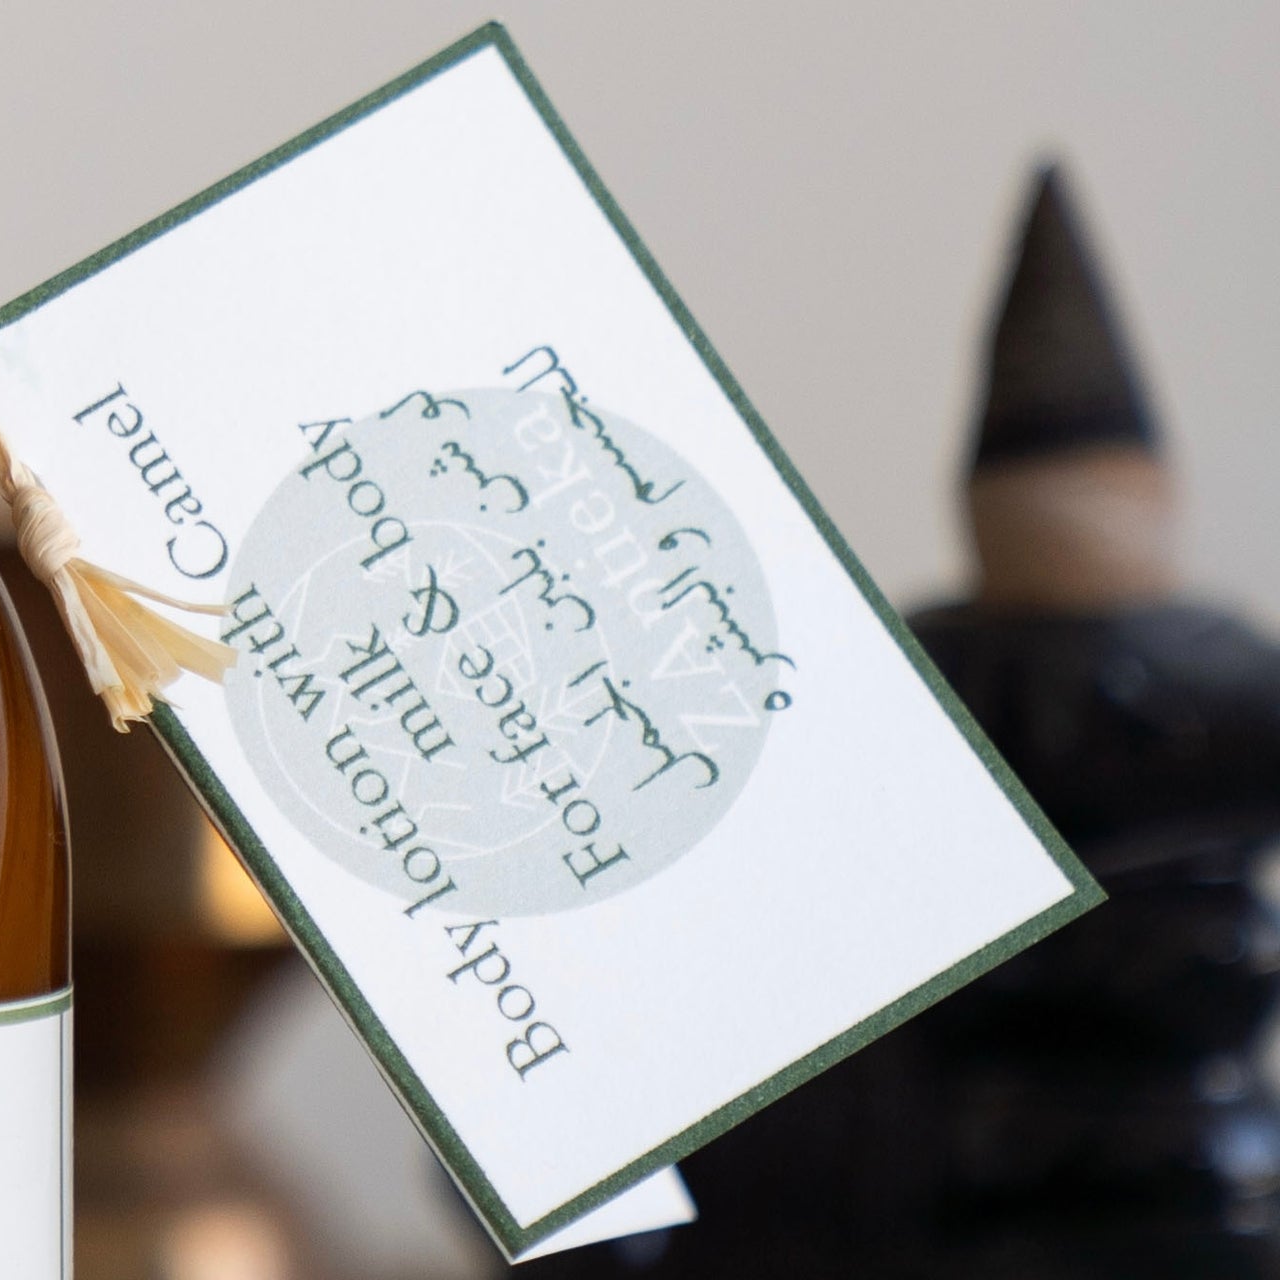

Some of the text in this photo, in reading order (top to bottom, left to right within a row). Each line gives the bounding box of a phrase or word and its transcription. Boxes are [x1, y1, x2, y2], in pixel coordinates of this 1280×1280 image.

[378, 389, 720, 791] لوشن بلبن الجمل
[501, 344, 685, 505] للجسم
[71, 381, 570, 1082] Body lotion with Camel
[297, 416, 630, 888] For face & body
[337, 622, 456, 762] milk
